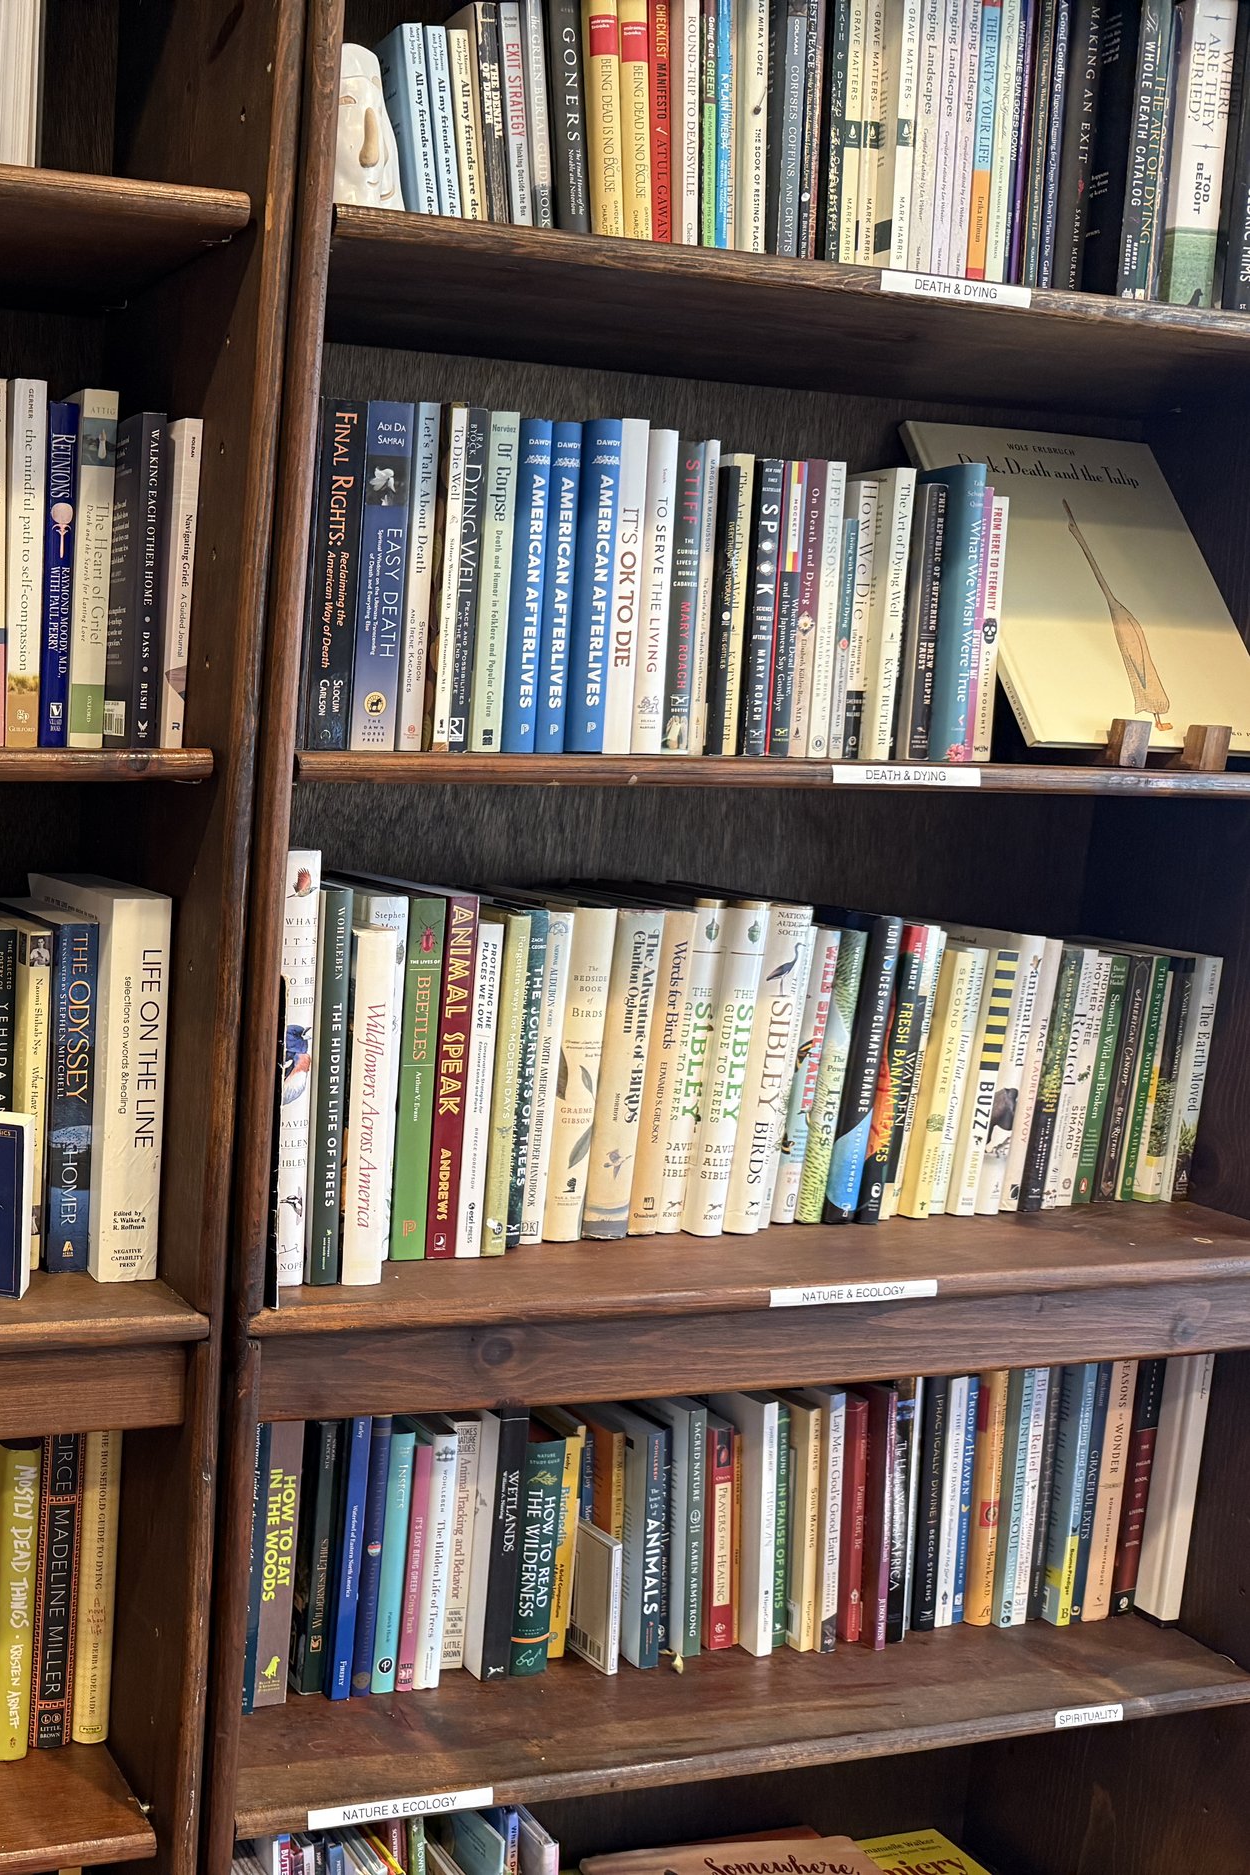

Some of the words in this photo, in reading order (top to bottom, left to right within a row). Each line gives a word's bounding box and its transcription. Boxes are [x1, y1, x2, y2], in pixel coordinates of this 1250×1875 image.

[506, 43, 519, 71] EXIT
[687, 16, 697, 97] ROUND-TRIP
[1085, 6, 1101, 81] MAKING
[508, 75, 525, 137] STRATEGY
[562, 27, 579, 141] GONERS
[686, 101, 696, 118] TO
[789, 66, 799, 122] CORPSES,
[1083, 89, 1093, 112] AN
[686, 122, 696, 196] DEADSVILLE
[1079, 122, 1091, 164] EXIT
[786, 184, 794, 206] AND
[1192, 161, 1205, 214] BENOIT
[1201, 174, 1212, 204] TOD
[784, 210, 794, 252] CRYPTS
[915, 279, 950, 293] DEATH
[953, 284, 962, 295] &
[964, 286, 998, 300] DYING
[334, 412, 357, 466] FINAL
[52, 433, 75, 499] REUNIONS
[682, 459, 700, 525] STIFF
[1007, 462, 1052, 478] Death
[1054, 466, 1079, 481] and
[1083, 471, 1102, 484] the
[1103, 466, 1139, 489] Tulip
[329, 475, 354, 546] RIGHTS:
[464, 463, 484, 533] DYING
[527, 475, 546, 583] AMERICAN
[595, 475, 613, 582] AMERICAN
[622, 508, 639, 545] IT'S
[384, 528, 402, 580] EASY
[457, 536, 477, 596] WELL
[620, 551, 637, 585] OK
[379, 591, 398, 658] DEATH
[618, 591, 634, 624] TO
[520, 588, 539, 708] AFTERLIVES
[586, 586, 607, 707] AFTERLIVES
[614, 630, 631, 668] DIE
[866, 770, 900, 780] DEATH
[904, 771, 910, 780] &
[914, 771, 946, 781] DYING
[73, 933, 88, 976] THE
[143, 949, 161, 993] LIFE
[445, 905, 474, 1018] ANIMAL
[140, 1000, 160, 1041] ON
[332, 1002, 342, 1032] THE
[413, 975, 431, 1060] BEETLES
[571, 1007, 603, 1018] BIRDS
[66, 980, 91, 1103] ODYSSEY
[137, 1045, 157, 1091] THE
[330, 1040, 341, 1094] HIDDEN
[357, 1003, 385, 1098] Wildflowers
[722, 1003, 753, 1120] SIBLEY
[757, 1001, 792, 1112] SIBLEY
[438, 1031, 465, 1116] SPEAK
[134, 1097, 155, 1149] LINE
[328, 1100, 339, 1132] LIFE
[361, 1101, 377, 1154] Across
[973, 1082, 994, 1130] BUZZ
[327, 1136, 337, 1157] OF
[746, 1121, 769, 1184] BIRDS
[62, 1149, 78, 1225] HOMER
[325, 1163, 336, 1207] TREES
[357, 1159, 377, 1228] America
[437, 1148, 450, 1222] ANDREWS
[801, 1288, 843, 1301] NATURE
[845, 1288, 854, 1299] &
[856, 1284, 906, 1299] ECOLOGY
[270, 1469, 283, 1488] IN
[281, 1475, 296, 1522] HOW
[397, 1465, 409, 1508] INSECTS
[268, 1493, 281, 1526] THE
[504, 1471, 519, 1551] WETLANDS
[49, 1509, 70, 1619] MADELINE
[279, 1527, 293, 1551] TO
[262, 1531, 278, 1601] WOODS
[278, 1556, 291, 1585] EAT
[643, 1519, 659, 1615] ANIMALS
[45, 1627, 64, 1695] MILLER
[1059, 1710, 1118, 1724] SPIRITUALITY
[343, 1804, 389, 1821] NATURE
[392, 1803, 401, 1815] &
[403, 1796, 456, 1815] ECOLOGY
